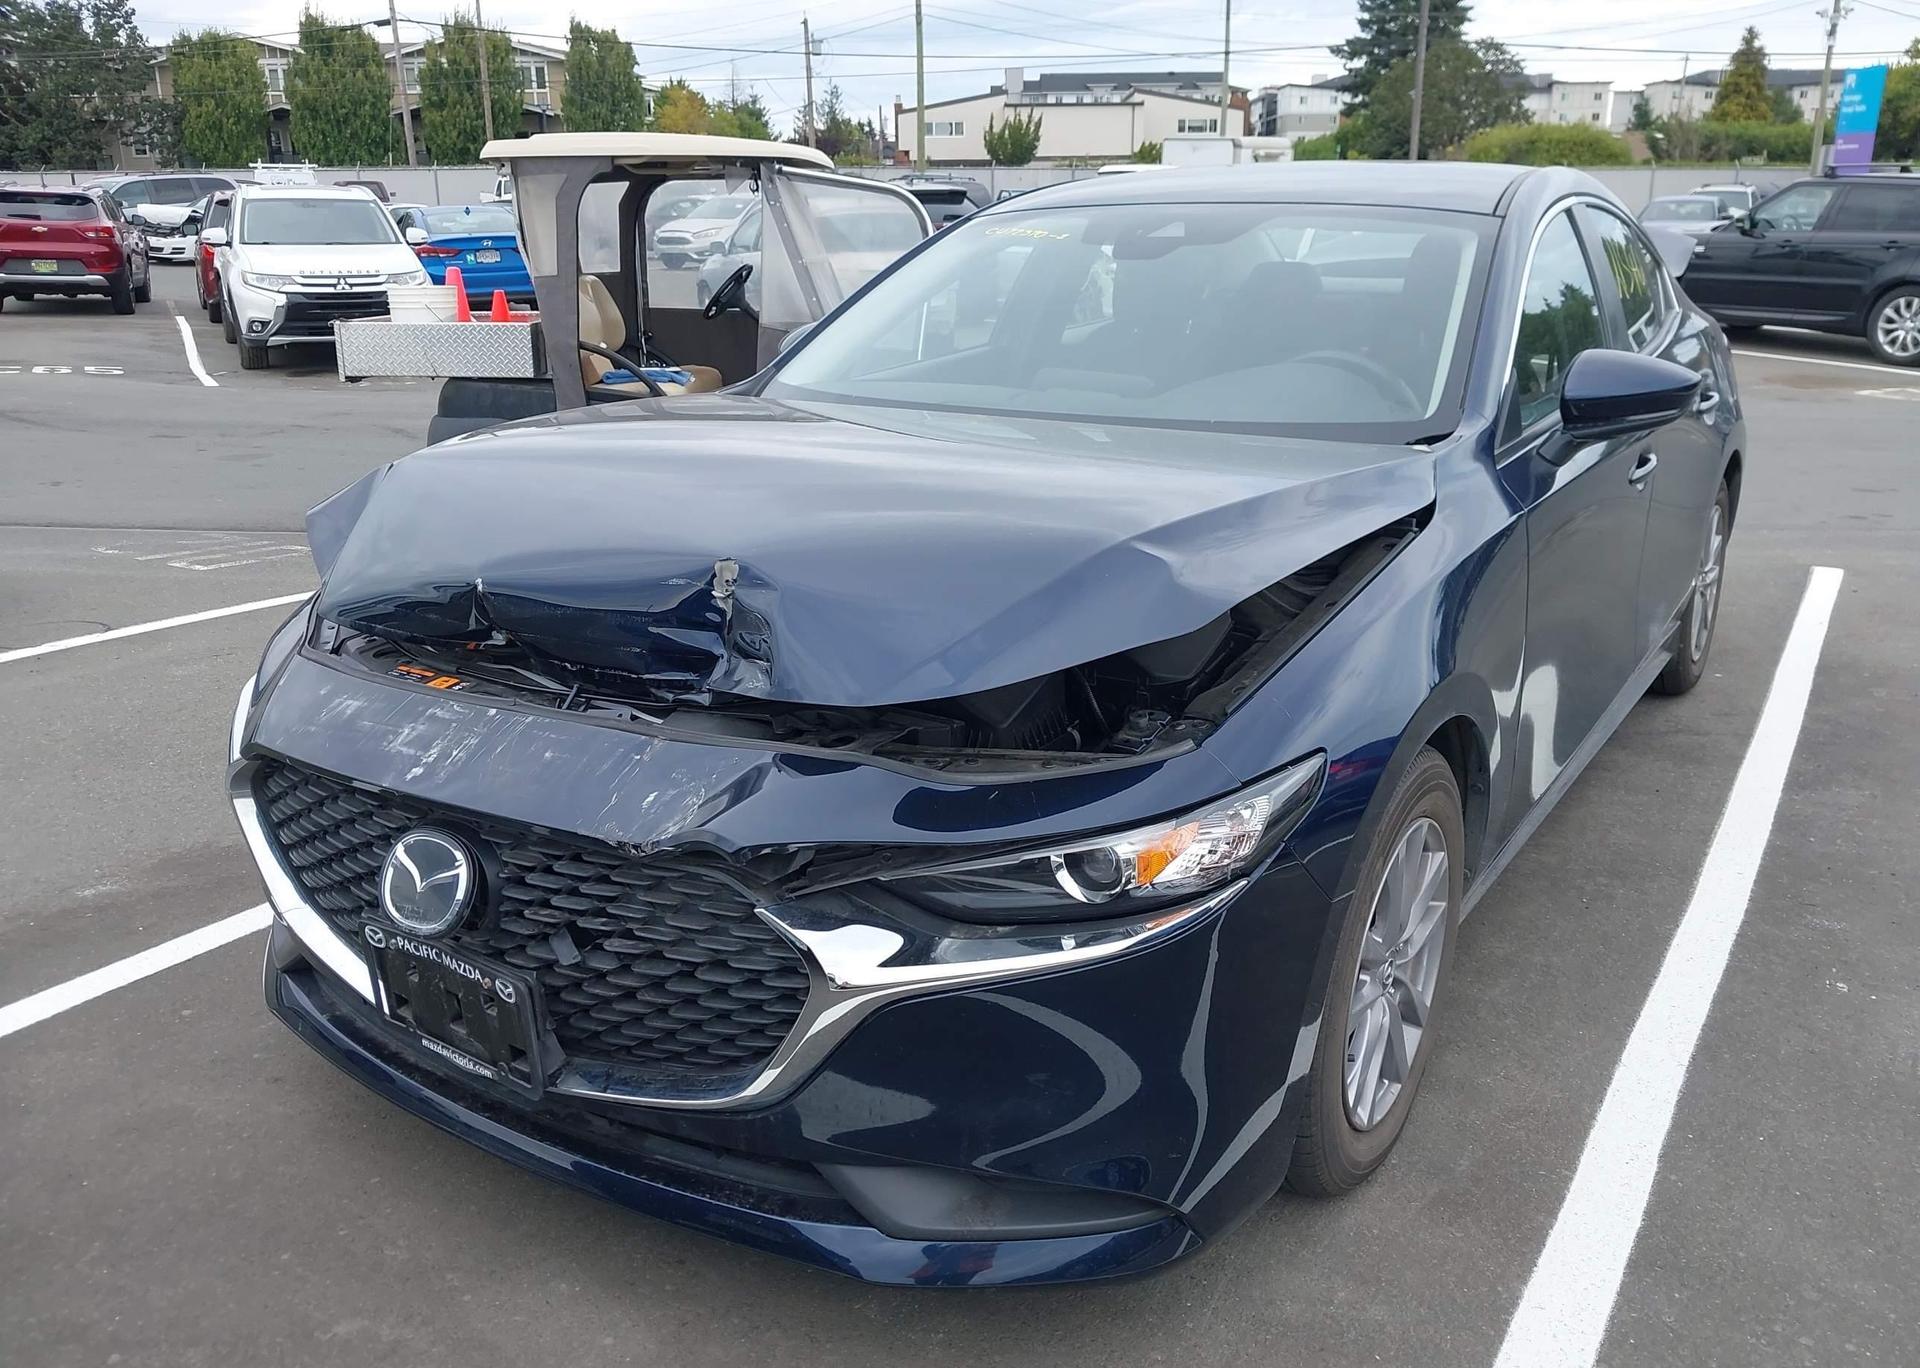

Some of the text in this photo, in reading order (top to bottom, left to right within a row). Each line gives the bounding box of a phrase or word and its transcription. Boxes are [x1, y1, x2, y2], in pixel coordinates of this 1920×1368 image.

[397, 936, 483, 983] PACIFIC MAZDA
[421, 1037, 494, 1079] mazdavictoria.com
